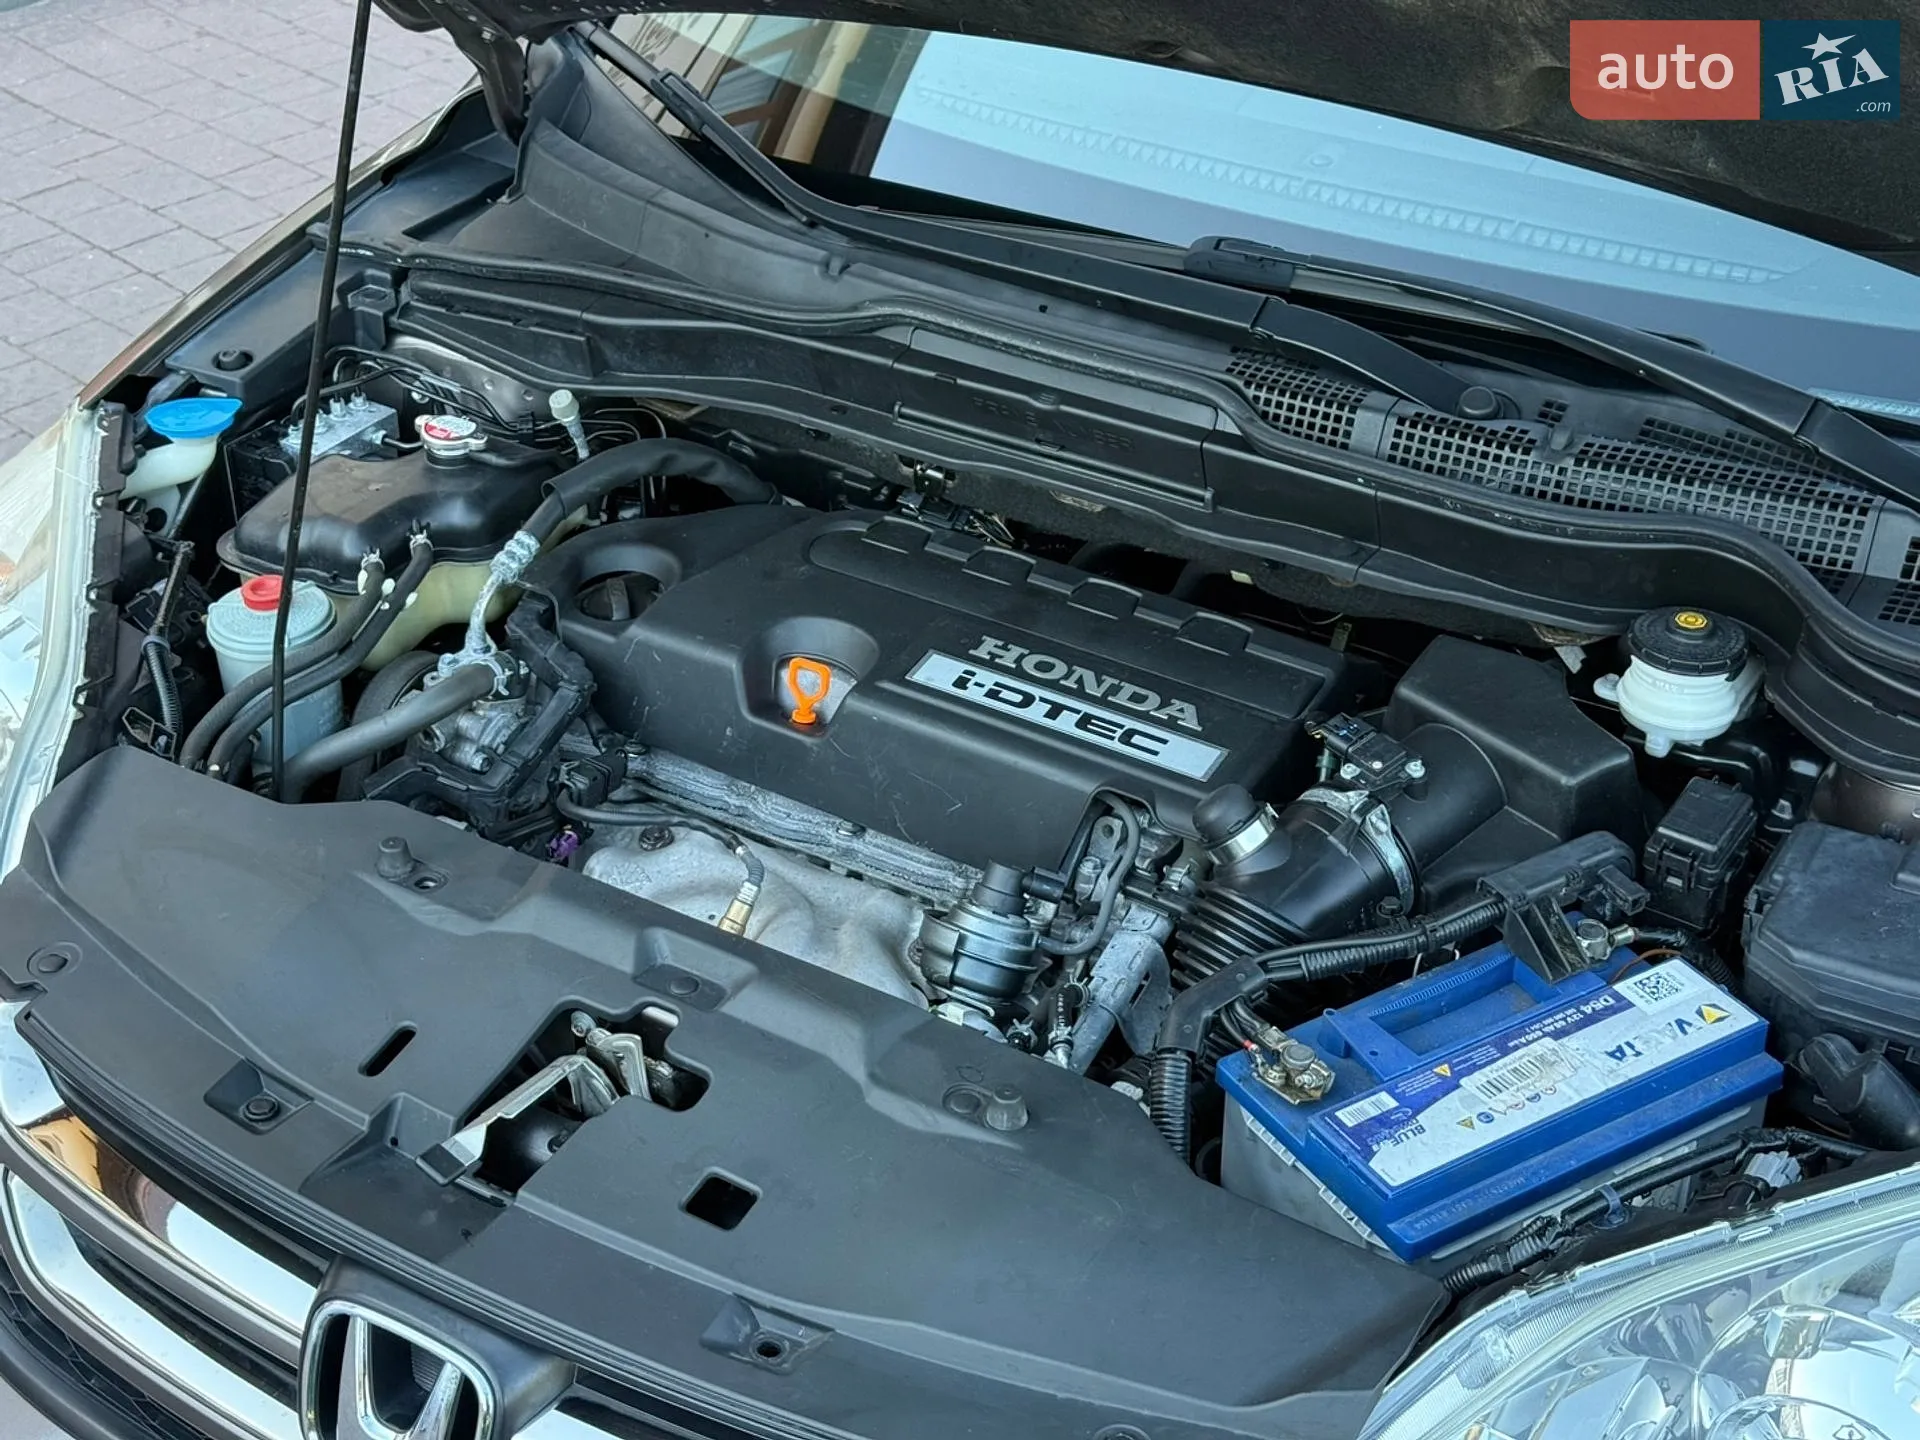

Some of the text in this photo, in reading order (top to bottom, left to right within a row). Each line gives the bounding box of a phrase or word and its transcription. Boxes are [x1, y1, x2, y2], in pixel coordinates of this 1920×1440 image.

[968, 634, 1204, 732] HONDA
[952, 669, 1169, 757] i-DTEC
[1580, 994, 1617, 1015] D54
[1604, 1018, 1703, 1061] VTA
[1390, 1122, 1427, 1148] BLUE
